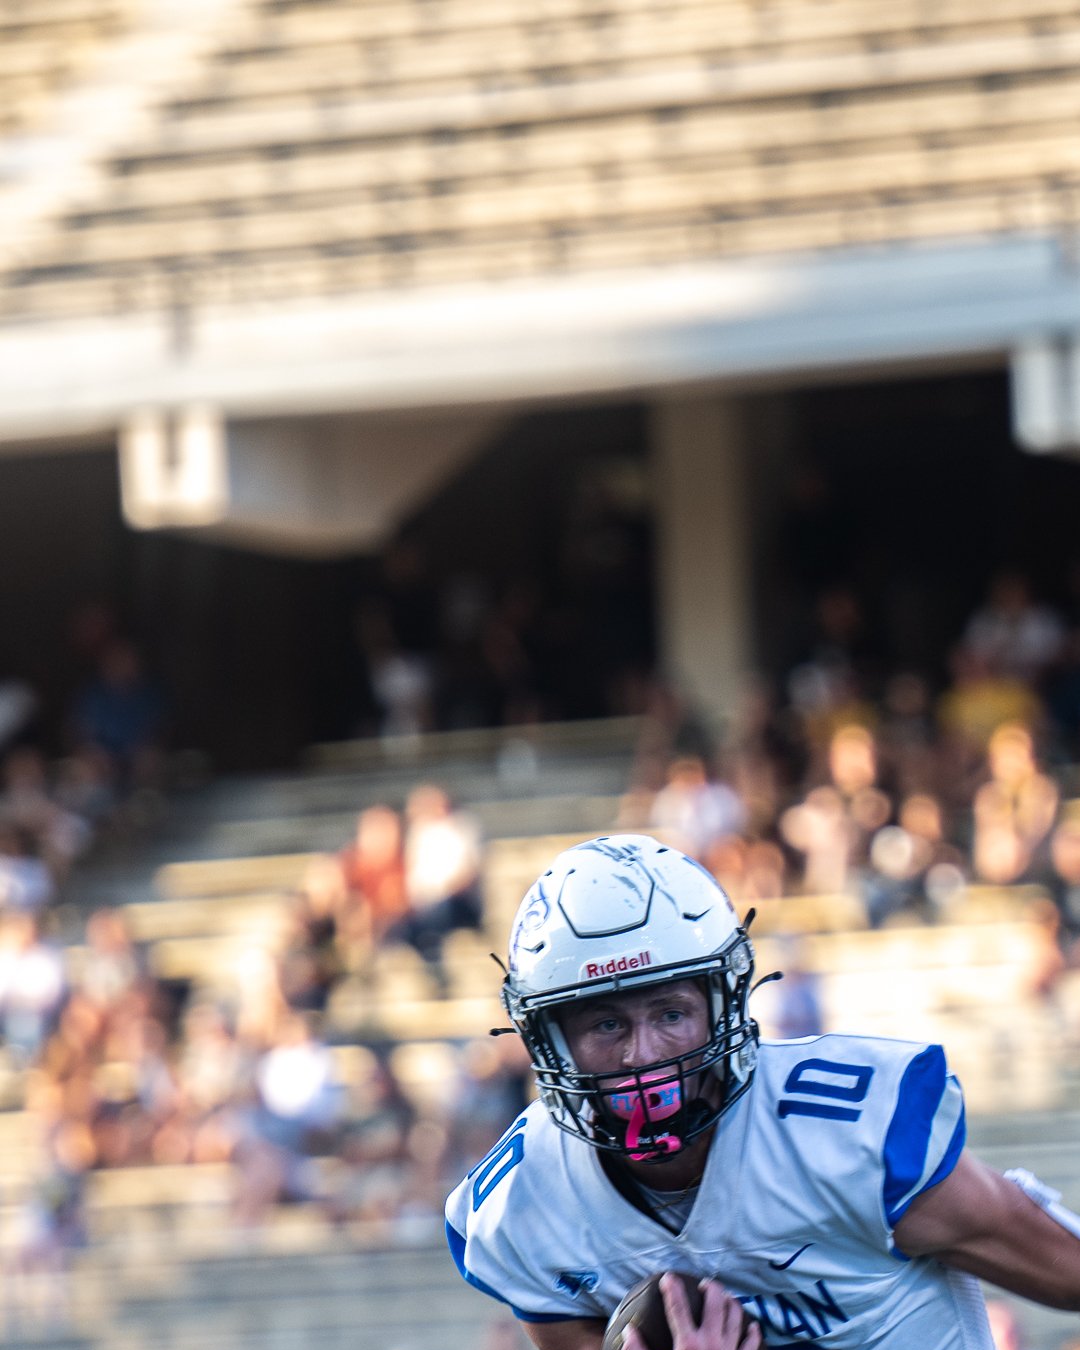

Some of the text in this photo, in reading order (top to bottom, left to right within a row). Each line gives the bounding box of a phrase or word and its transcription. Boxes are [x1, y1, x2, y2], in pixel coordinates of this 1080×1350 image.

[586, 950, 652, 979] Riddell
[777, 1058, 875, 1122] 10
[467, 1117, 526, 1212] 10
